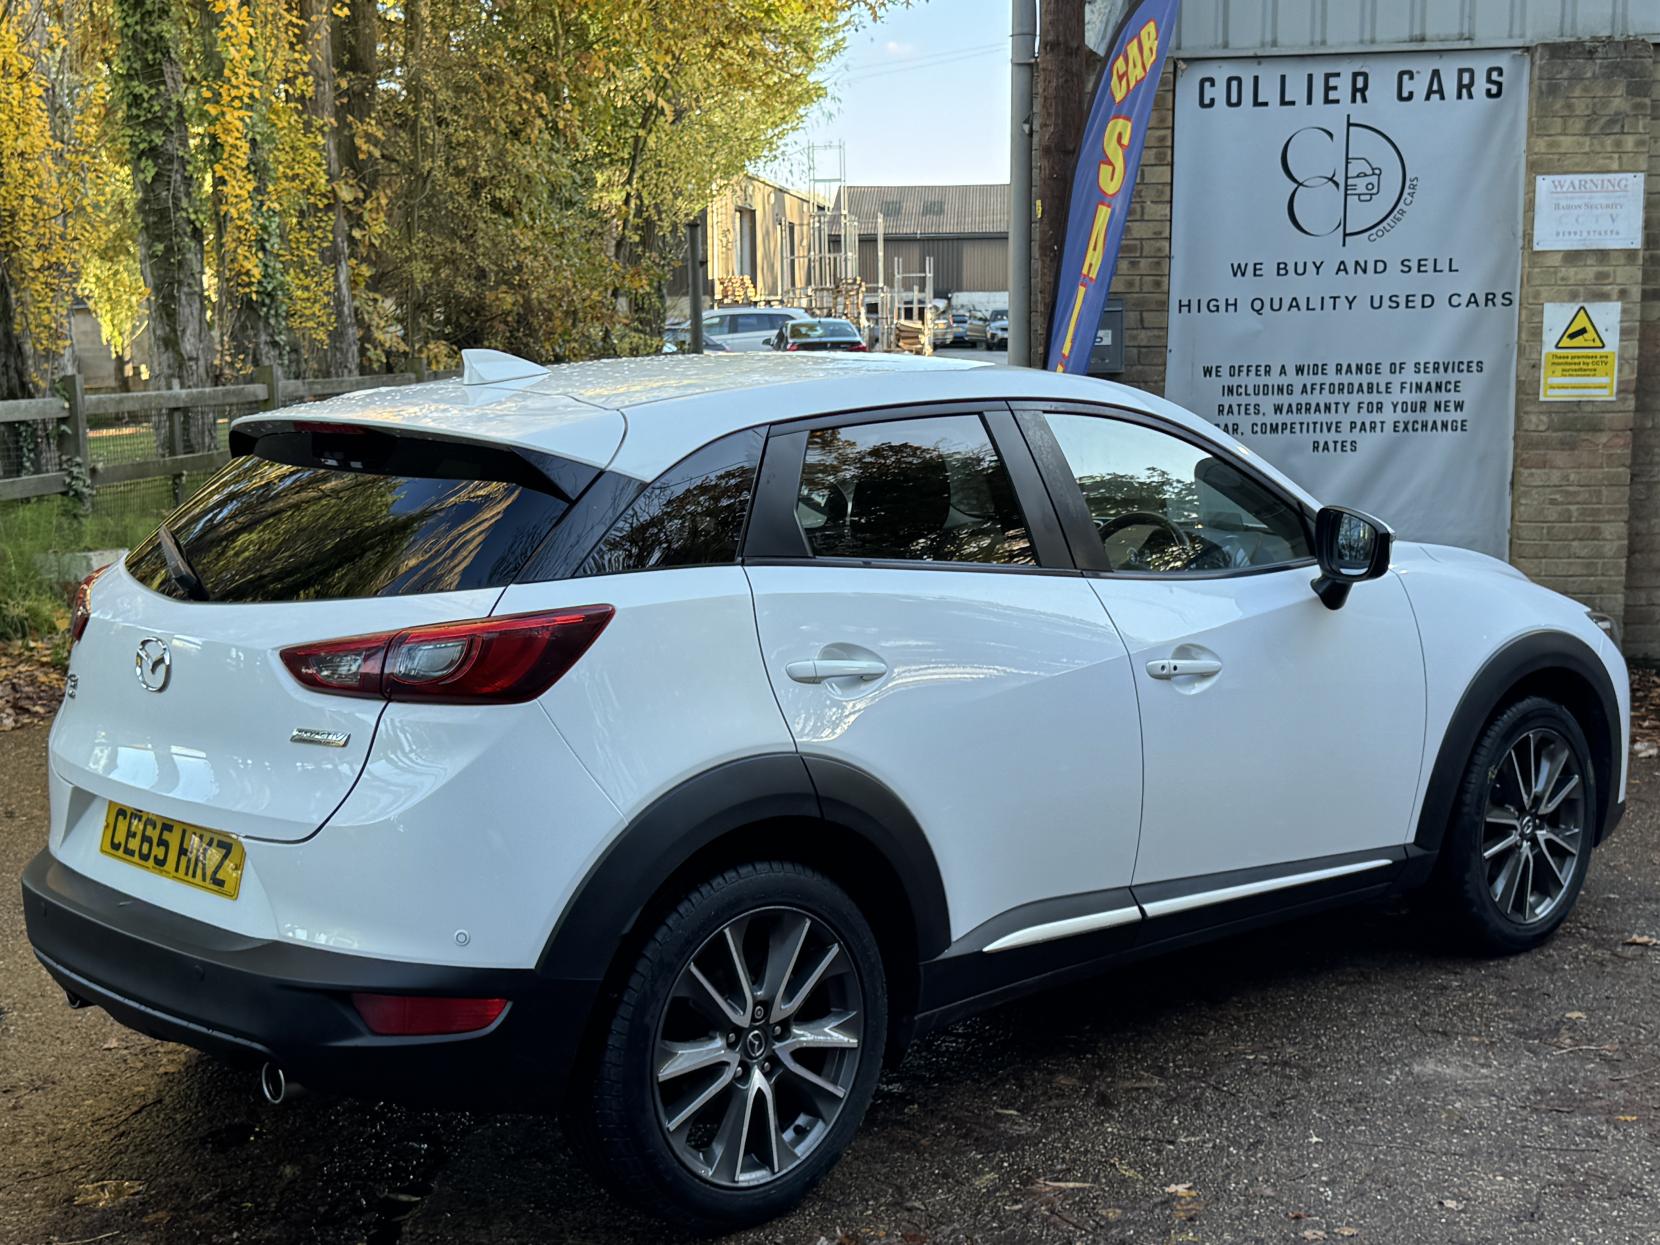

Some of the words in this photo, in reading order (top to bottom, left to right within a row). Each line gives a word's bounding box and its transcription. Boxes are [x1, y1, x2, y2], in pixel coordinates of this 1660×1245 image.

[1198, 71, 1370, 109] COLLIER
[1396, 66, 1504, 102] CARS
[1551, 177, 1629, 191] WARNING
[1367, 208, 1407, 243] COLLIER
[1403, 176, 1419, 206] CARS
[1231, 262, 1264, 278] WE
[1276, 260, 1325, 277] BUY
[1335, 259, 1388, 276] AND
[1400, 257, 1459, 274] SELL
[1178, 297, 1238, 314] HIGH
[1250, 295, 1358, 315] QUALITY
[1370, 294, 1435, 310] USED
[1447, 292, 1514, 308] CARS
[1202, 365, 1222, 378] WE
[1229, 364, 1271, 377] OFFER
[1279, 364, 1288, 377] A
[1294, 363, 1329, 376] WIDE
[1335, 362, 1382, 375] RANGE
[1389, 361, 1407, 374] OF
[1413, 360, 1484, 374] SERVICES
[1221, 383, 1294, 397] INCLUDING
[1301, 381, 1393, 395] AFFORDABLE
[1399, 380, 1462, 394] FINANCE
[1217, 402, 1267, 416] RATES,
[1273, 401, 1350, 415] WARRANTY
[1357, 401, 1384, 414] FOR
[1391, 400, 1427, 413] YOUR
[1433, 399, 1465, 412] NEW
[1214, 422, 1244, 436] AR,
[1250, 421, 1342, 435] COMPETITIVE
[1349, 420, 1385, 433] PART
[1392, 419, 1468, 433] EXCHANGE
[1311, 440, 1358, 453] RATES
[110, 807, 174, 868] CE65
[174, 828, 234, 888] HKZ
